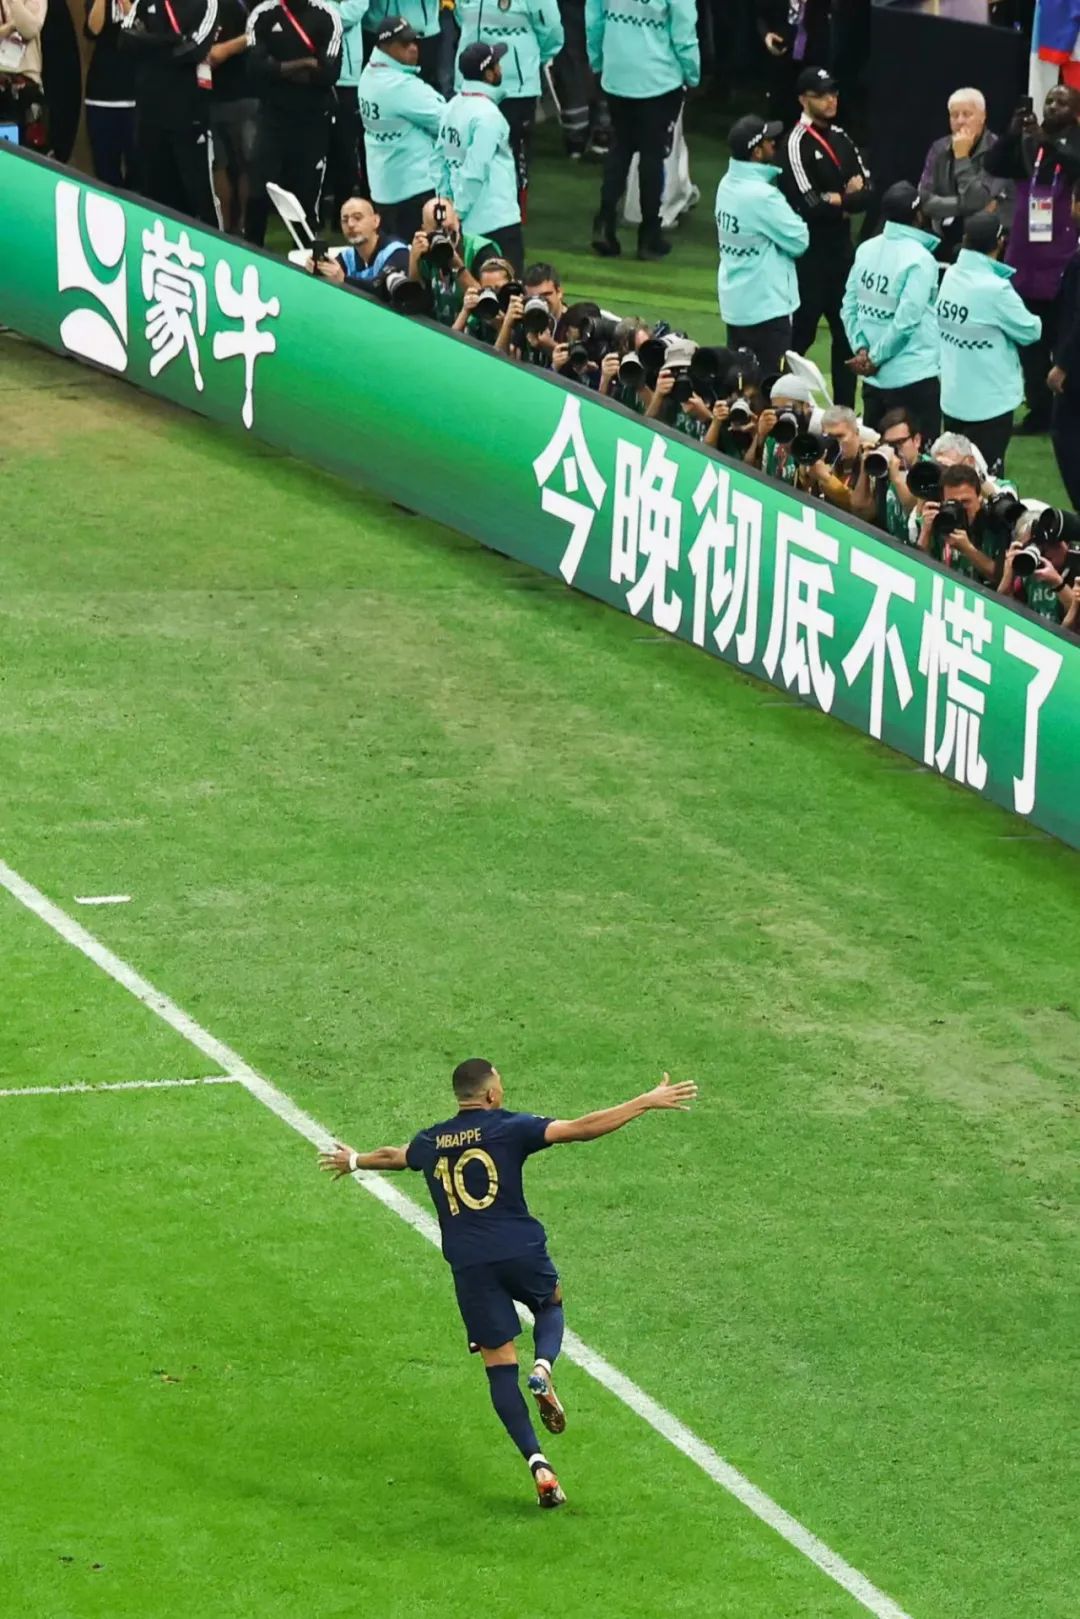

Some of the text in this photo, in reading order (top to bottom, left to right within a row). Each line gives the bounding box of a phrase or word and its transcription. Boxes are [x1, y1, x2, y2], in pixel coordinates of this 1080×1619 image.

[860, 269, 889, 295] 4612
[141, 218, 280, 430] 蒙牛
[532, 393, 1064, 815] 今晚彻底不慌了
[435, 1127, 482, 1149] MBAPPE
[433, 1147, 499, 1217] 10
